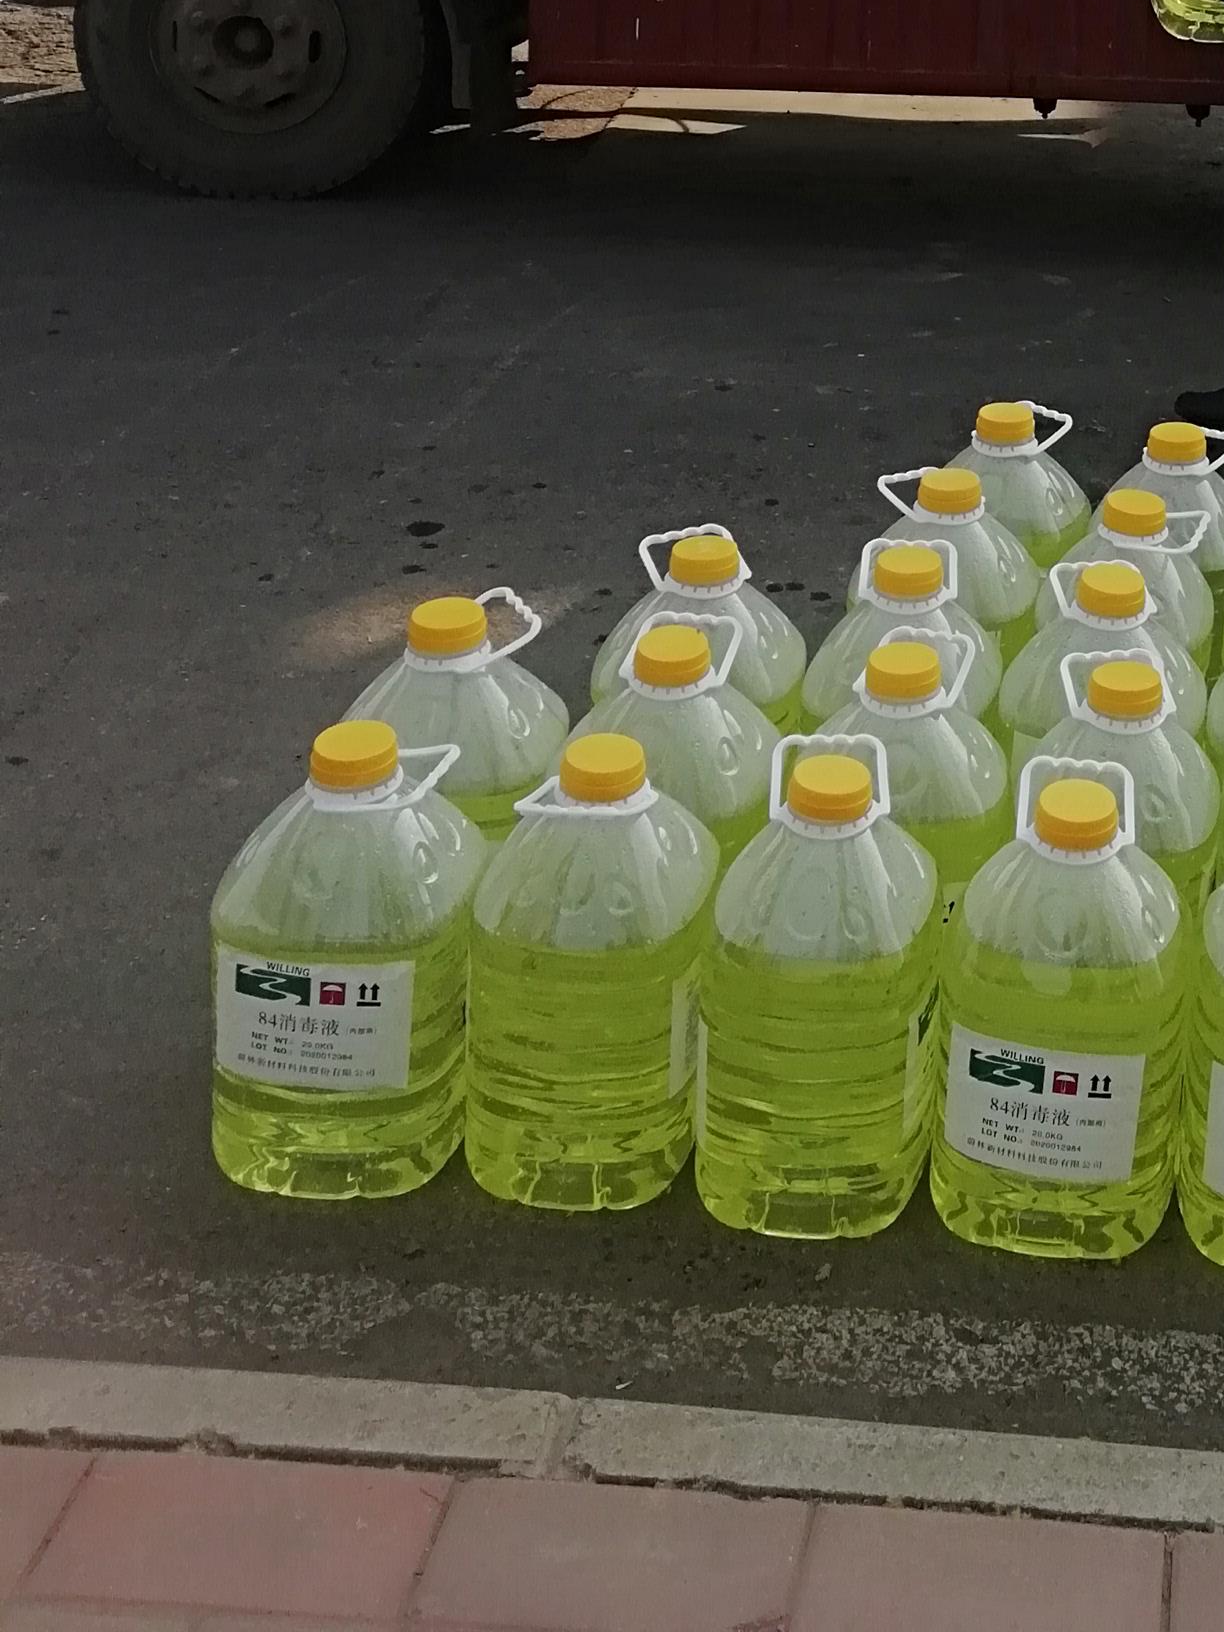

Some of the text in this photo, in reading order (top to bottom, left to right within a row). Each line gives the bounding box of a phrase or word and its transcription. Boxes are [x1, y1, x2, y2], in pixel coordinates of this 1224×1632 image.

[267, 961, 310, 976] WILLING
[258, 1011, 340, 1037] 84消毒液
[251, 1031, 269, 1041] NET
[251, 1041, 268, 1050] LOT
[1000, 1048, 1045, 1065] WILLING
[989, 1097, 1071, 1127] 84消毒液
[982, 1117, 998, 1128] NET
[981, 1127, 997, 1138] LOT
